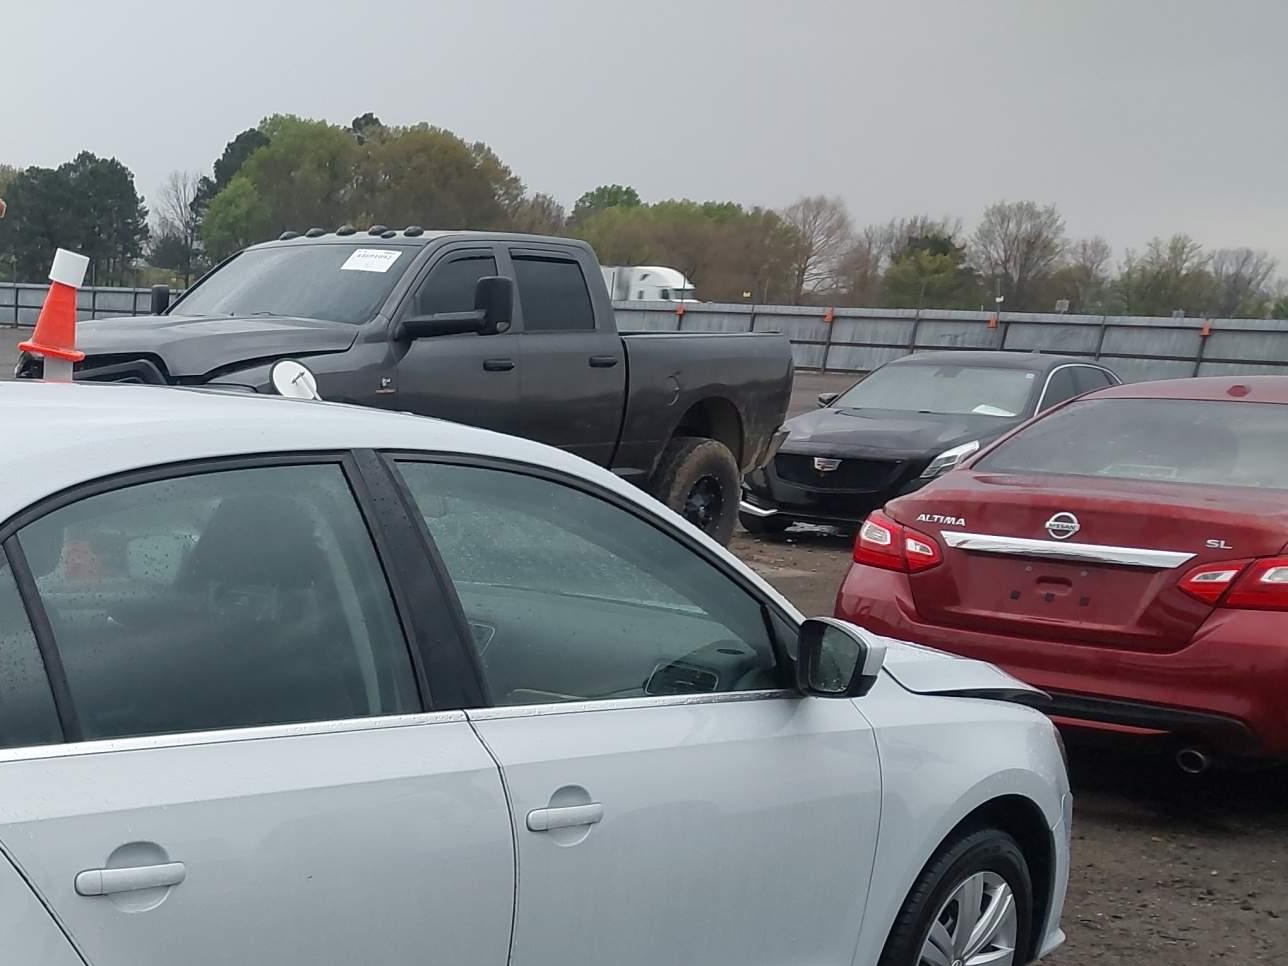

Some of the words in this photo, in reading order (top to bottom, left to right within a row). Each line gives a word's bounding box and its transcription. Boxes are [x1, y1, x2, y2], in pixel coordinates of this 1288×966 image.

[916, 513, 966, 526] ALTIMA
[1048, 521, 1077, 530] NISSAN
[1205, 539, 1233, 549] SL
